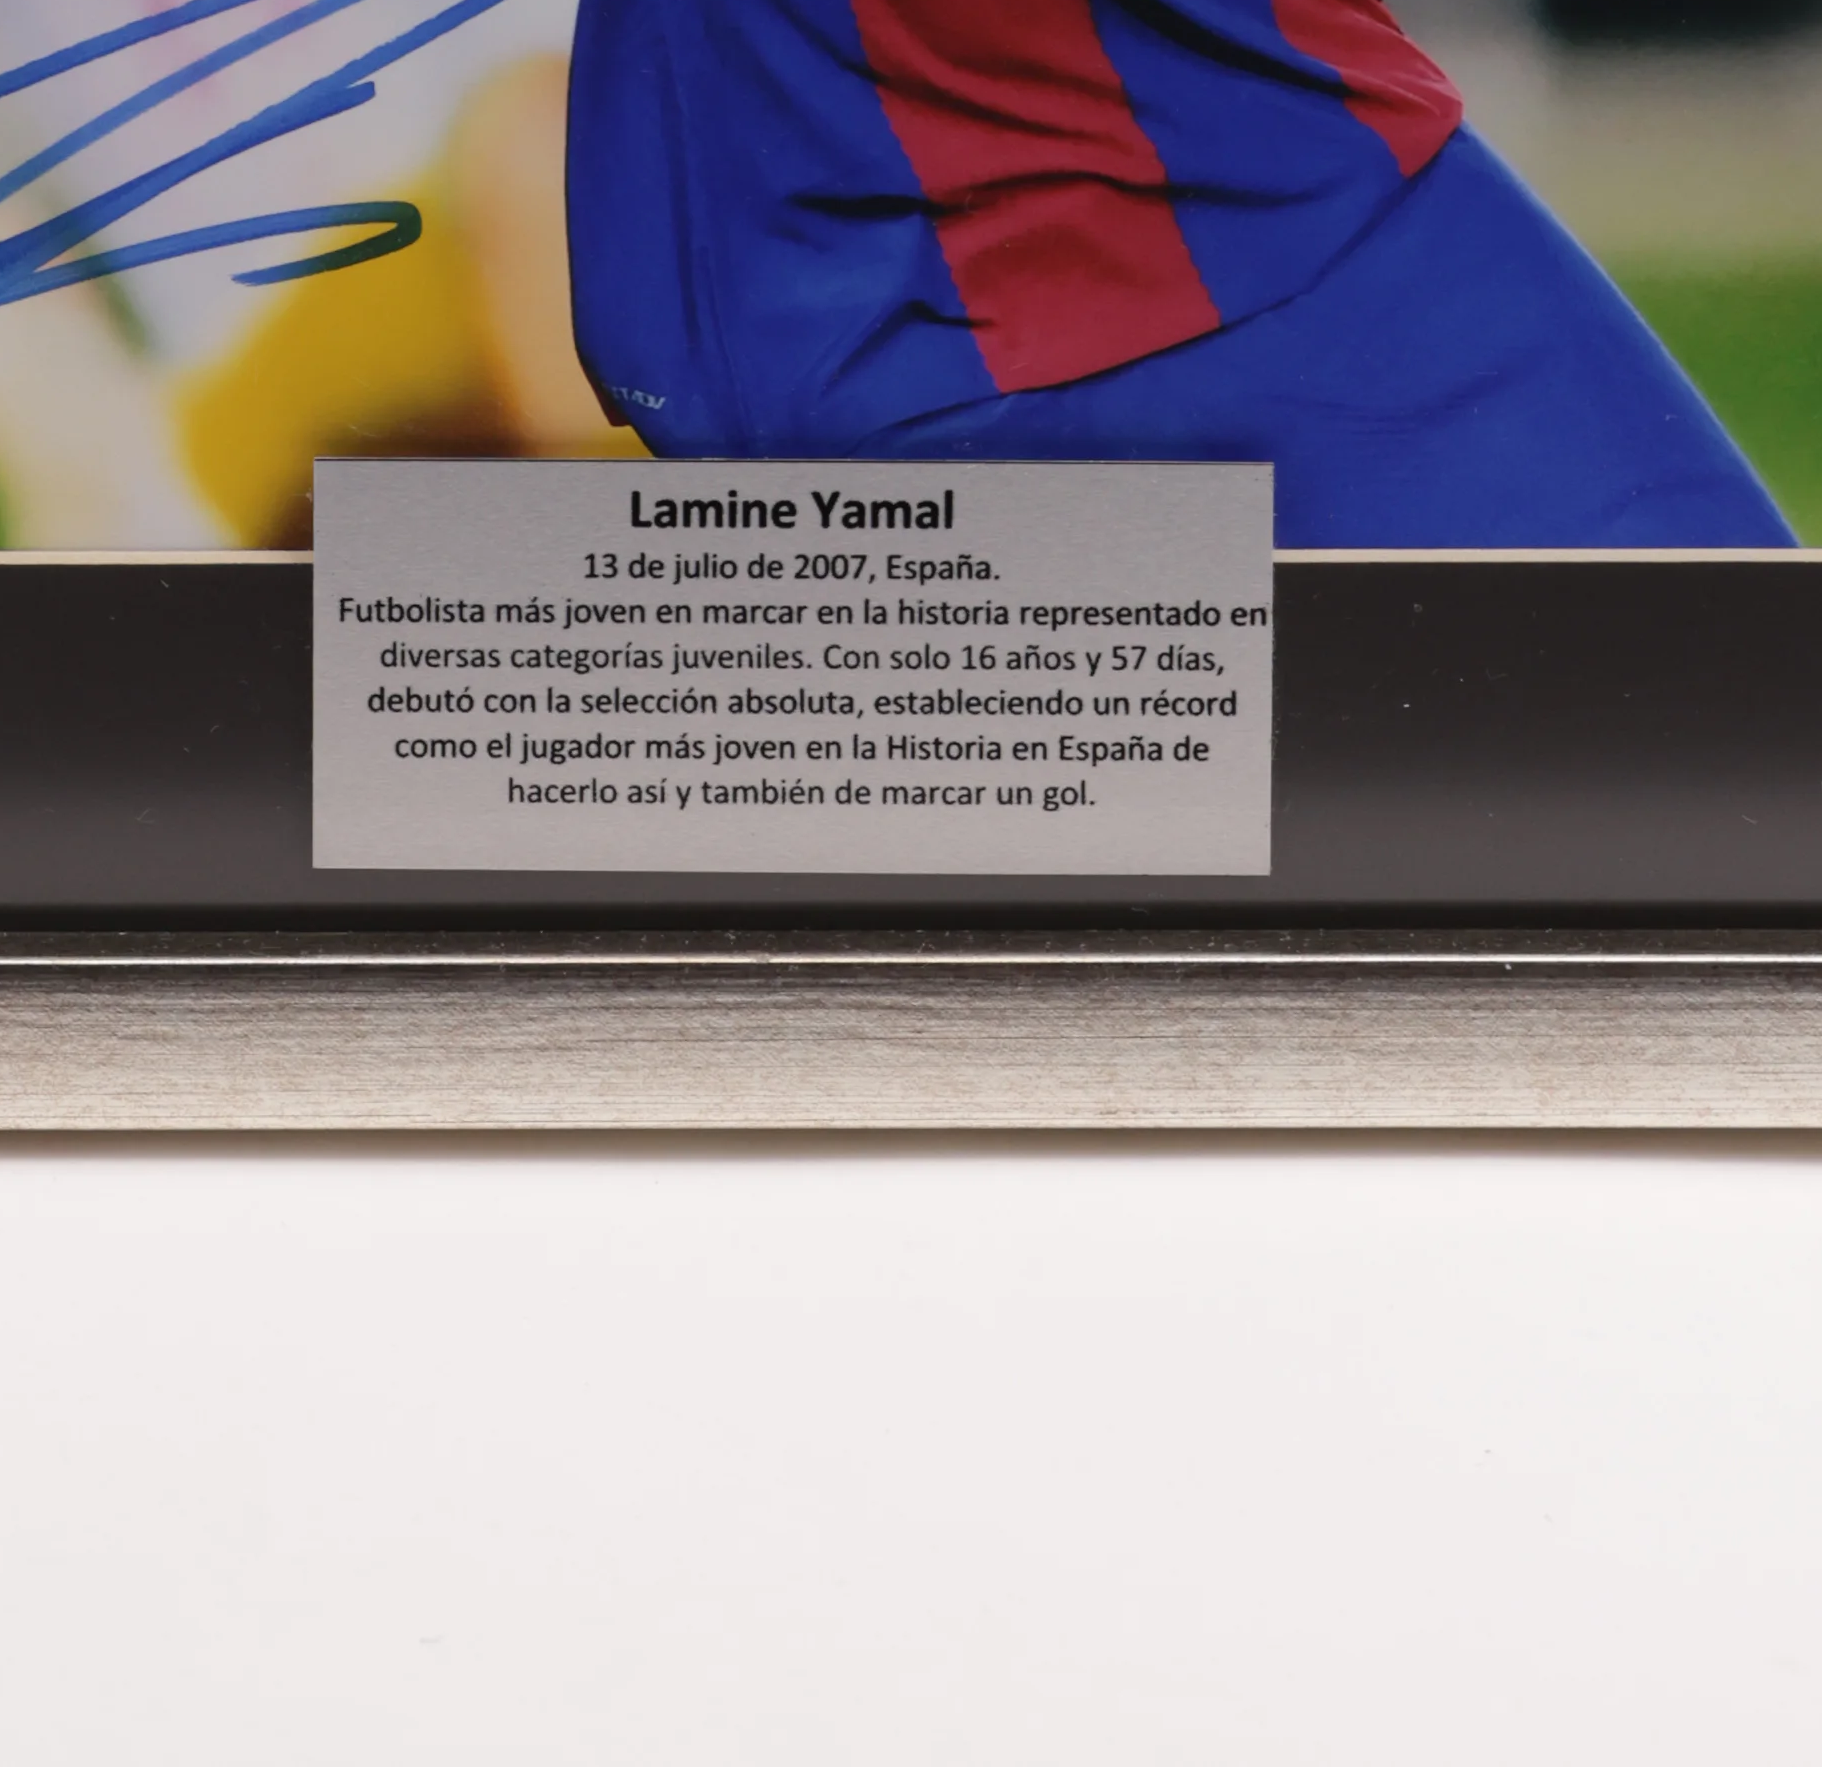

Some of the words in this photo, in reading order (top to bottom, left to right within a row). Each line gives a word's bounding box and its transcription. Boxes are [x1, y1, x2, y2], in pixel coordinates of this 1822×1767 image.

[630, 489, 798, 530] Lamine
[810, 489, 955, 530] Yamal
[584, 552, 619, 579] 13
[627, 551, 665, 580] de
[672, 552, 739, 586] julio
[746, 552, 784, 580] de
[793, 553, 876, 585] 2007,
[886, 553, 1001, 586] España.
[339, 596, 486, 624] Futbolista
[495, 596, 556, 624] más
[562, 597, 646, 630] joven
[655, 603, 692, 625] en
[702, 604, 809, 625] marcar
[816, 605, 854, 625] en
[863, 597, 888, 626] la
[898, 598, 1010, 626] historia
[1019, 599, 1222, 632] representado
[1230, 606, 1268, 627] en
[380, 640, 502, 669] diversas
[510, 641, 664, 675] categorías
[670, 642, 813, 676] juveniles.
[823, 643, 880, 670] Con
[889, 642, 951, 671] solo
[962, 644, 997, 671] 16
[1006, 644, 1077, 671] años
[1085, 651, 1102, 677] y
[1111, 645, 1147, 671] 57
[1157, 644, 1224, 676] días,
[367, 686, 475, 714] debutó
[483, 693, 537, 714] con
[547, 686, 571, 714] la
[580, 686, 718, 715] selección
[727, 687, 864, 719] absoluta,
[873, 688, 1084, 716] estableciendo
[1093, 696, 1130, 716] un
[1140, 689, 1237, 717] récord
[394, 738, 477, 759] como
[486, 732, 512, 759] el
[519, 732, 636, 765] jugador
[645, 732, 706, 760] más
[712, 734, 796, 766] joven
[806, 740, 842, 760] en
[852, 733, 877, 760] la
[887, 734, 1002, 761] Historia
[1012, 741, 1048, 761] en
[1058, 735, 1163, 767] España
[1173, 735, 1210, 762] de
[508, 776, 618, 804] hacerlo
[627, 777, 667, 804] así
[676, 785, 692, 810] y
[701, 778, 825, 805] también
[834, 778, 871, 805] de
[882, 785, 987, 806] marcar
[996, 786, 1033, 806] un
[1042, 779, 1095, 812] gol.
